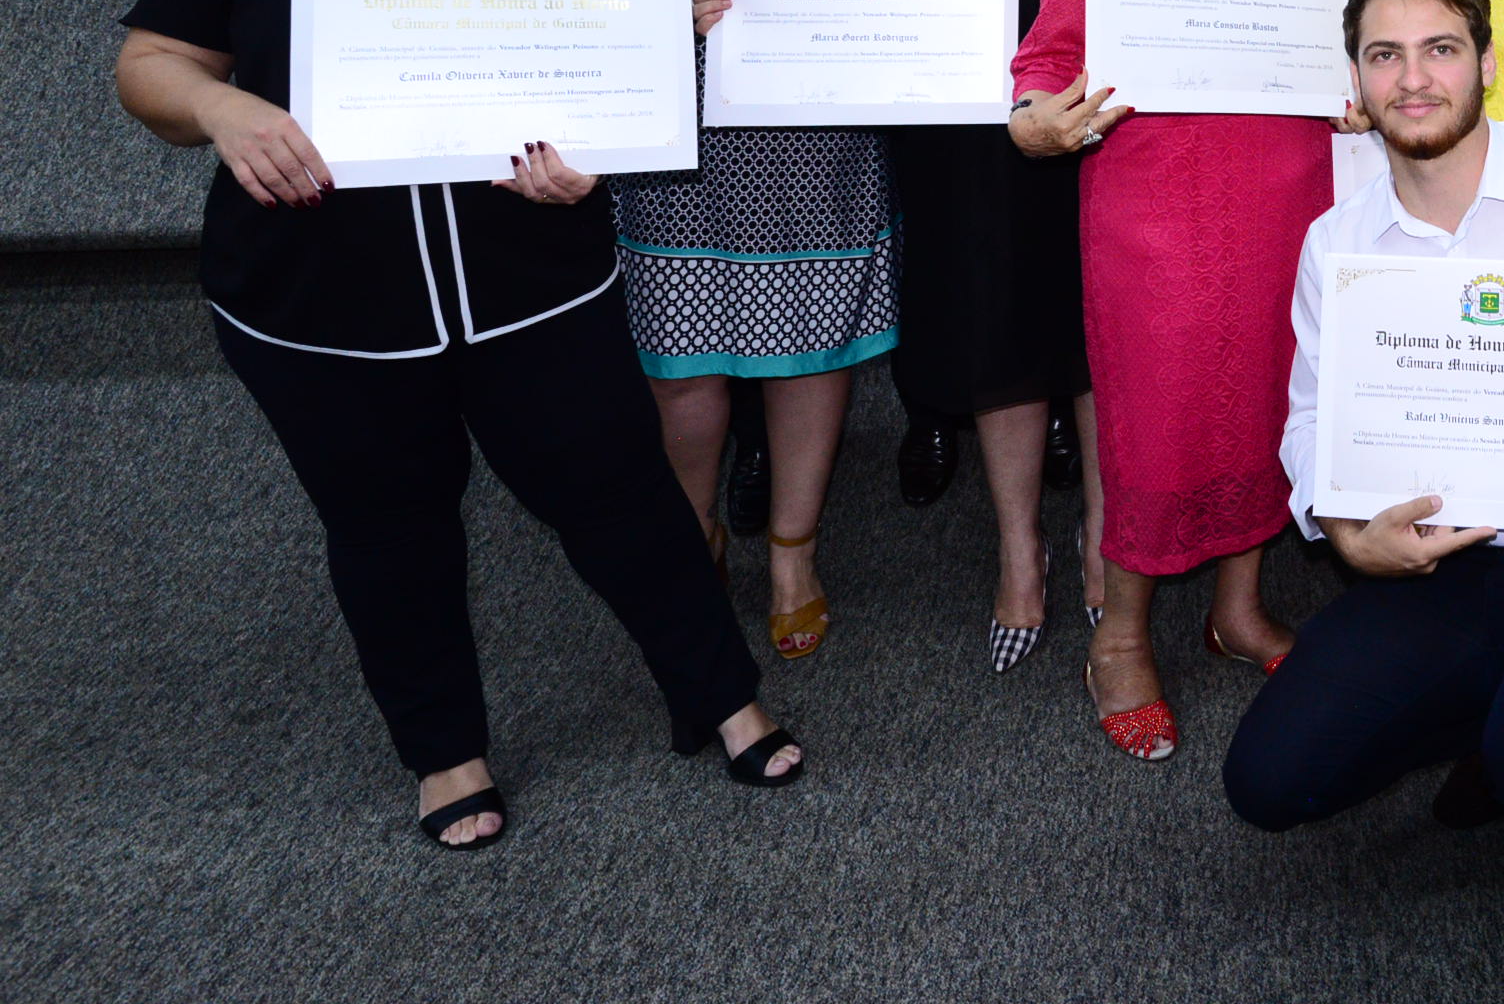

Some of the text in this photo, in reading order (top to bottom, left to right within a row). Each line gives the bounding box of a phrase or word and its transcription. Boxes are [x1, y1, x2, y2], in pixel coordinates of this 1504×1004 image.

[398, 70, 442, 82] Camila
[445, 69, 494, 81] Oliveira
[537, 68, 550, 79] de
[552, 67, 602, 80] Siqueira
[1375, 330, 1440, 351] Diploma
[1445, 335, 1463, 350] de
[1396, 355, 1443, 370] Câmara
[1404, 410, 1437, 423] Rafael
